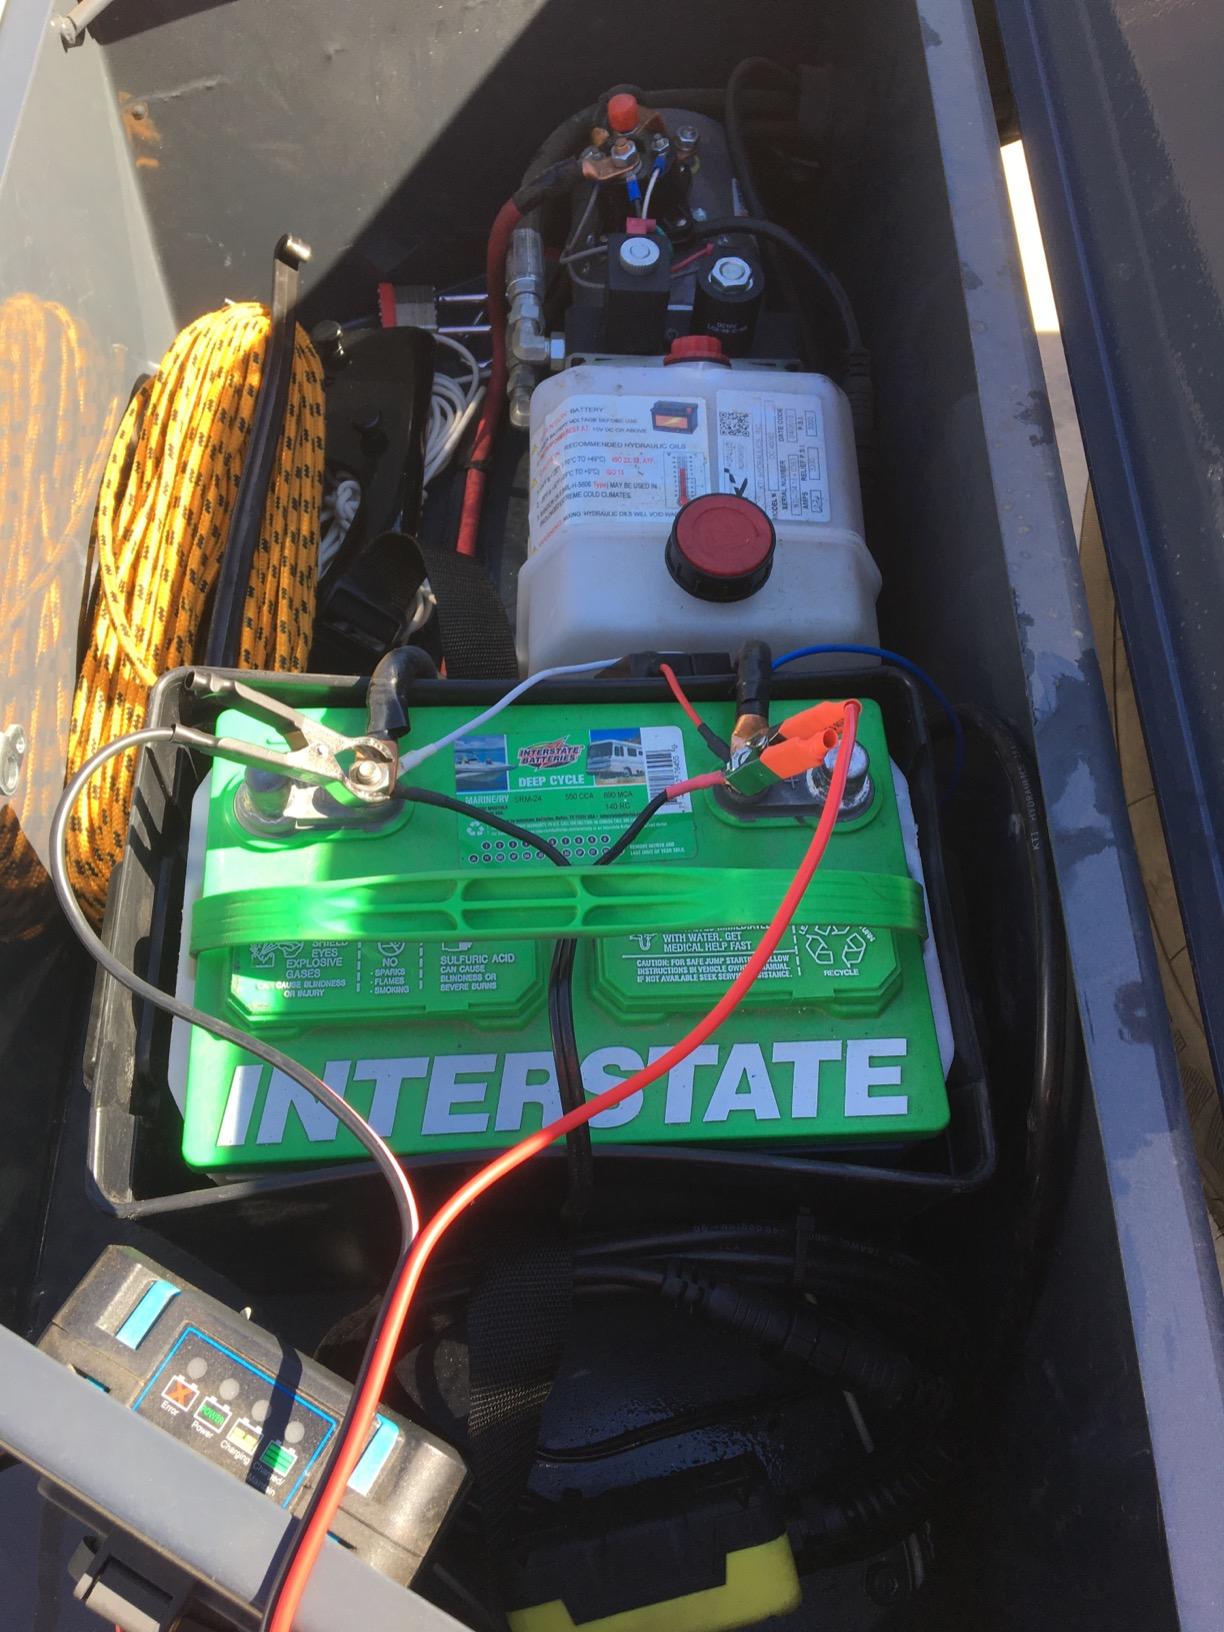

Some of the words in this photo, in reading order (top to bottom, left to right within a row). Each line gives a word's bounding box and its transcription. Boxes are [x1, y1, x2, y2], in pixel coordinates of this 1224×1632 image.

[776, 408, 784, 425] CODE
[776, 426, 785, 442] DATE
[564, 441, 623, 450] RECOMMENDED
[624, 442, 667, 450] HYDRAULIC
[584, 510, 618, 518] HYDRAULIC
[519, 745, 581, 758] INTERSTATE
[521, 755, 577, 765] BATTERIES
[518, 776, 547, 787] DEEP
[549, 774, 585, 786] CYCLE
[465, 794, 509, 804] MARINE/RV
[579, 792, 594, 800] CCA
[618, 790, 633, 799] MCA
[663, 934, 690, 943] WITH
[692, 933, 723, 942] WATER.
[725, 931, 742, 941] GET
[664, 942, 703, 953] MEDICAL
[705, 941, 728, 951] HELP
[730, 941, 752, 950] FAST
[311, 948, 338, 958] EYES
[286, 957, 343, 968] EXPLOSIVE
[382, 957, 399, 967] NO
[440, 954, 489, 965] SULFURIC
[491, 953, 516, 963] ACID
[637, 959, 670, 967] CAUTION:
[671, 958, 685, 967] FOR
[686, 957, 704, 966] SAFE
[705, 957, 724, 965] JUMP
[286, 969, 321, 979] GASES
[374, 967, 406, 977] SPARKS
[440, 966, 457, 974] CAN
[459, 965, 486, 973] CAUSE
[638, 966, 688, 975] INSTRUCTIONS
[690, 966, 699, 974] IN
[700, 964, 727, 973] VEHICLE
[824, 969, 860, 977] RECYCLE
[374, 977, 405, 986] FLAMES
[440, 974, 483, 983] BLINDNESS
[485, 973, 497, 981] OR
[661, 973, 699, 982] AVAILABLE
[700, 973, 717, 981] SEEK
[276, 981, 302, 989] CAUSE
[304, 979, 346, 988] BLINDNESS
[440, 983, 469, 992] SEVERE
[471, 982, 497, 991] BURNS
[284, 990, 296, 998] OR
[297, 989, 325, 998] INJURY
[374, 985, 410, 995] SMOKING
[217, 1038, 907, 1146] INTERSTATE
[161, 1399, 180, 1416] Error
[191, 1419, 214, 1440] Power
[220, 1439, 251, 1467] Charging
